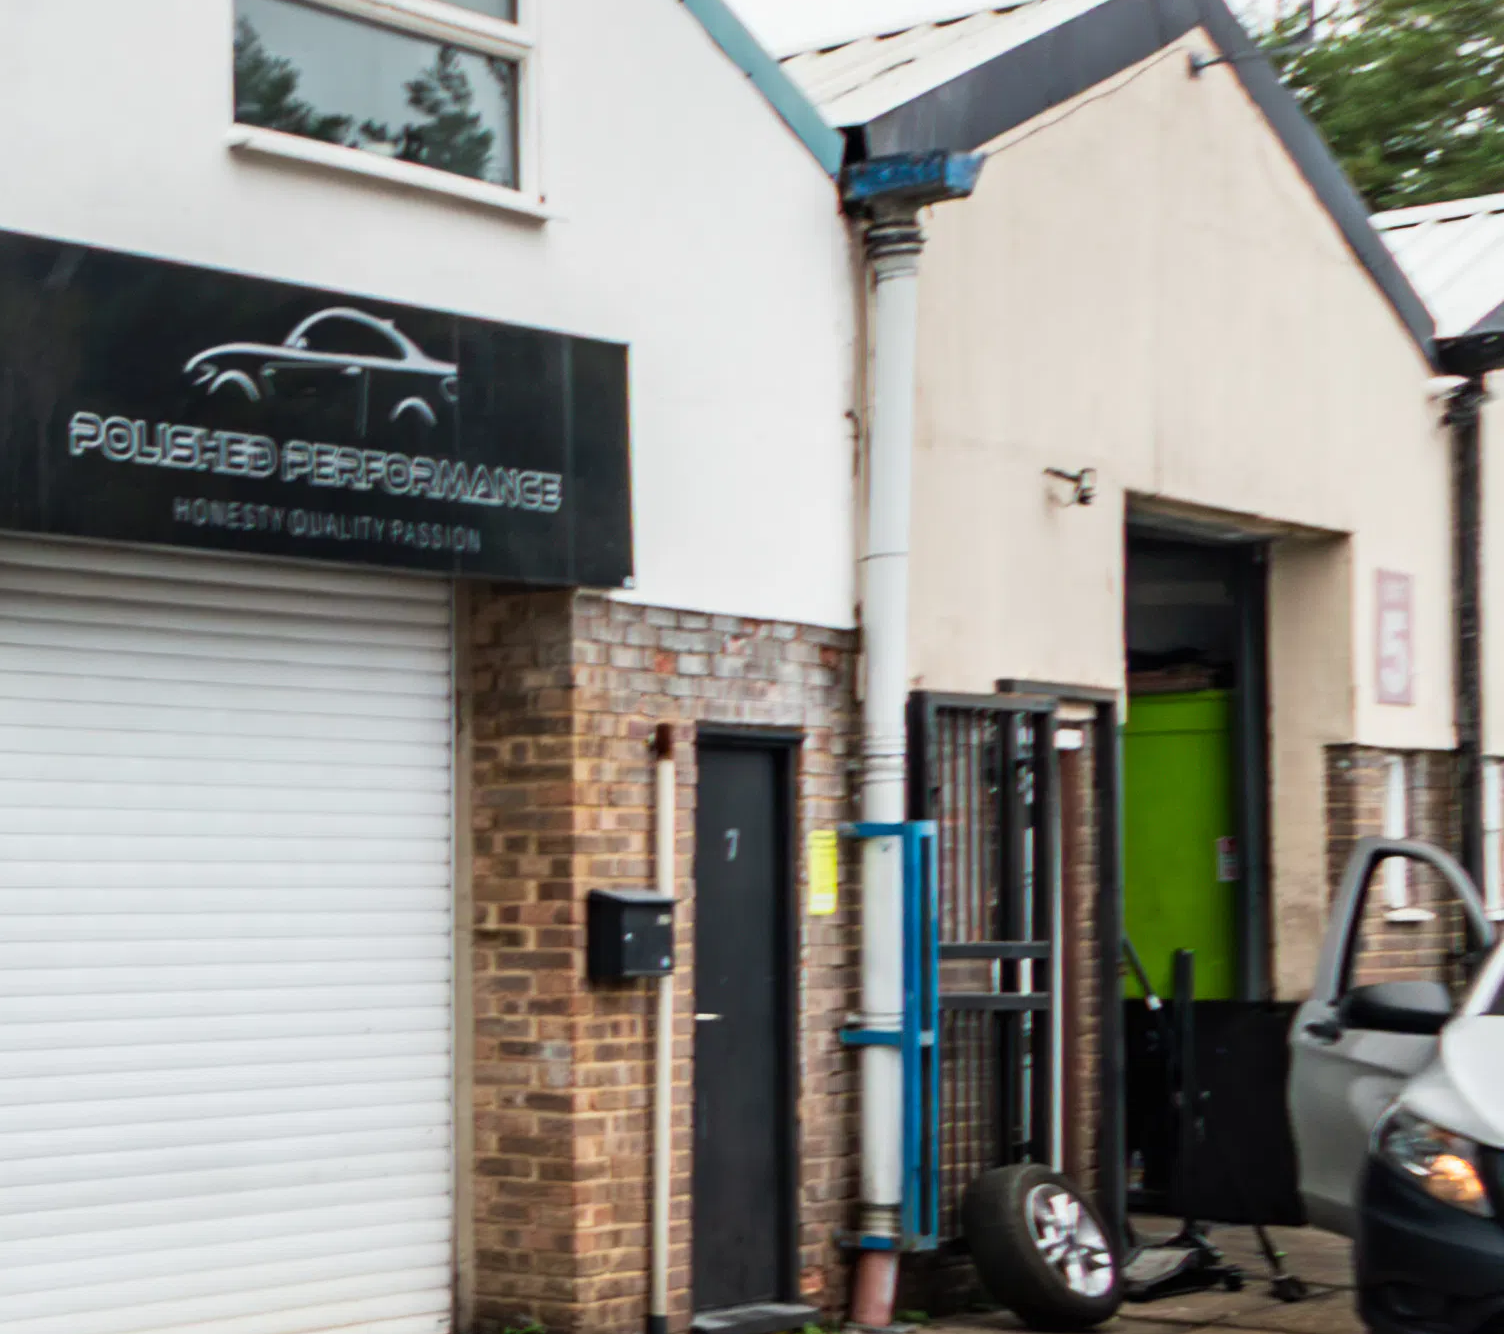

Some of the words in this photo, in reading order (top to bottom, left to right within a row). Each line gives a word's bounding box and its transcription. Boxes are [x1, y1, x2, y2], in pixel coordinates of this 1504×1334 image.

[68, 412, 277, 478] POLISHED
[281, 440, 563, 513] PERFORMANCE
[172, 496, 285, 532] HONESTY
[289, 508, 385, 543] QUALITY
[390, 519, 481, 554] PASSION
[1380, 610, 1410, 695] 5
[724, 827, 740, 862] 7
